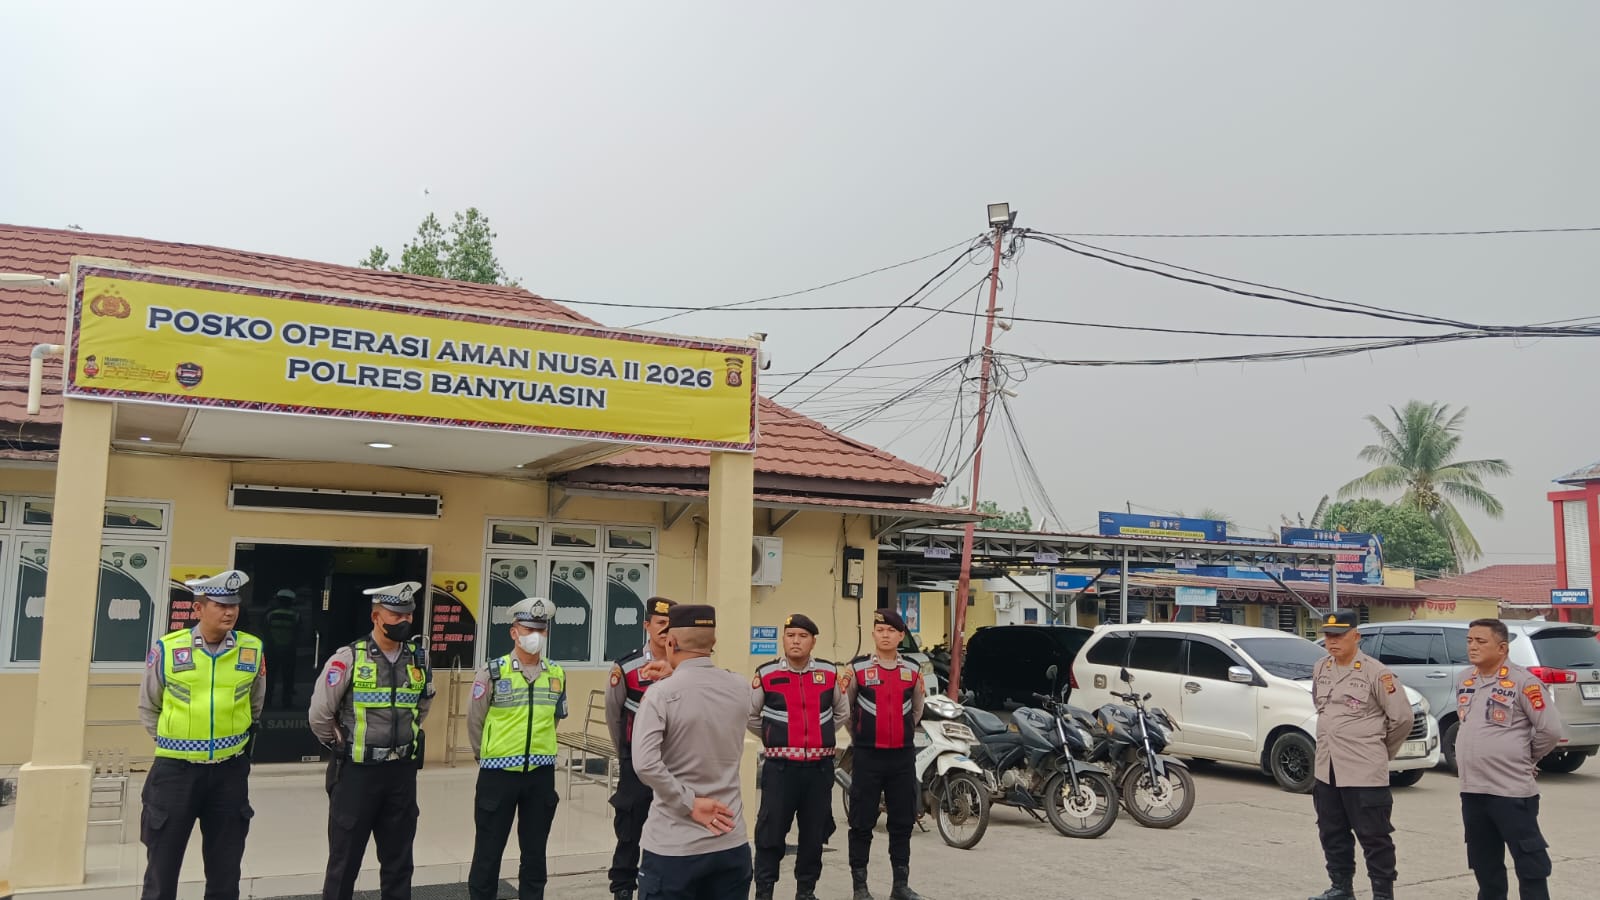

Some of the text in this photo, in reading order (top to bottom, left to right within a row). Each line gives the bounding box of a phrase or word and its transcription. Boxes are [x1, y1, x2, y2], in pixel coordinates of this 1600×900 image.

[148, 307, 712, 388] POSKO OPERASI AMAN NUSA II 2026
[288, 358, 605, 409] POLRES BANYUASIN
[1491, 687, 1516, 698] POLRI
